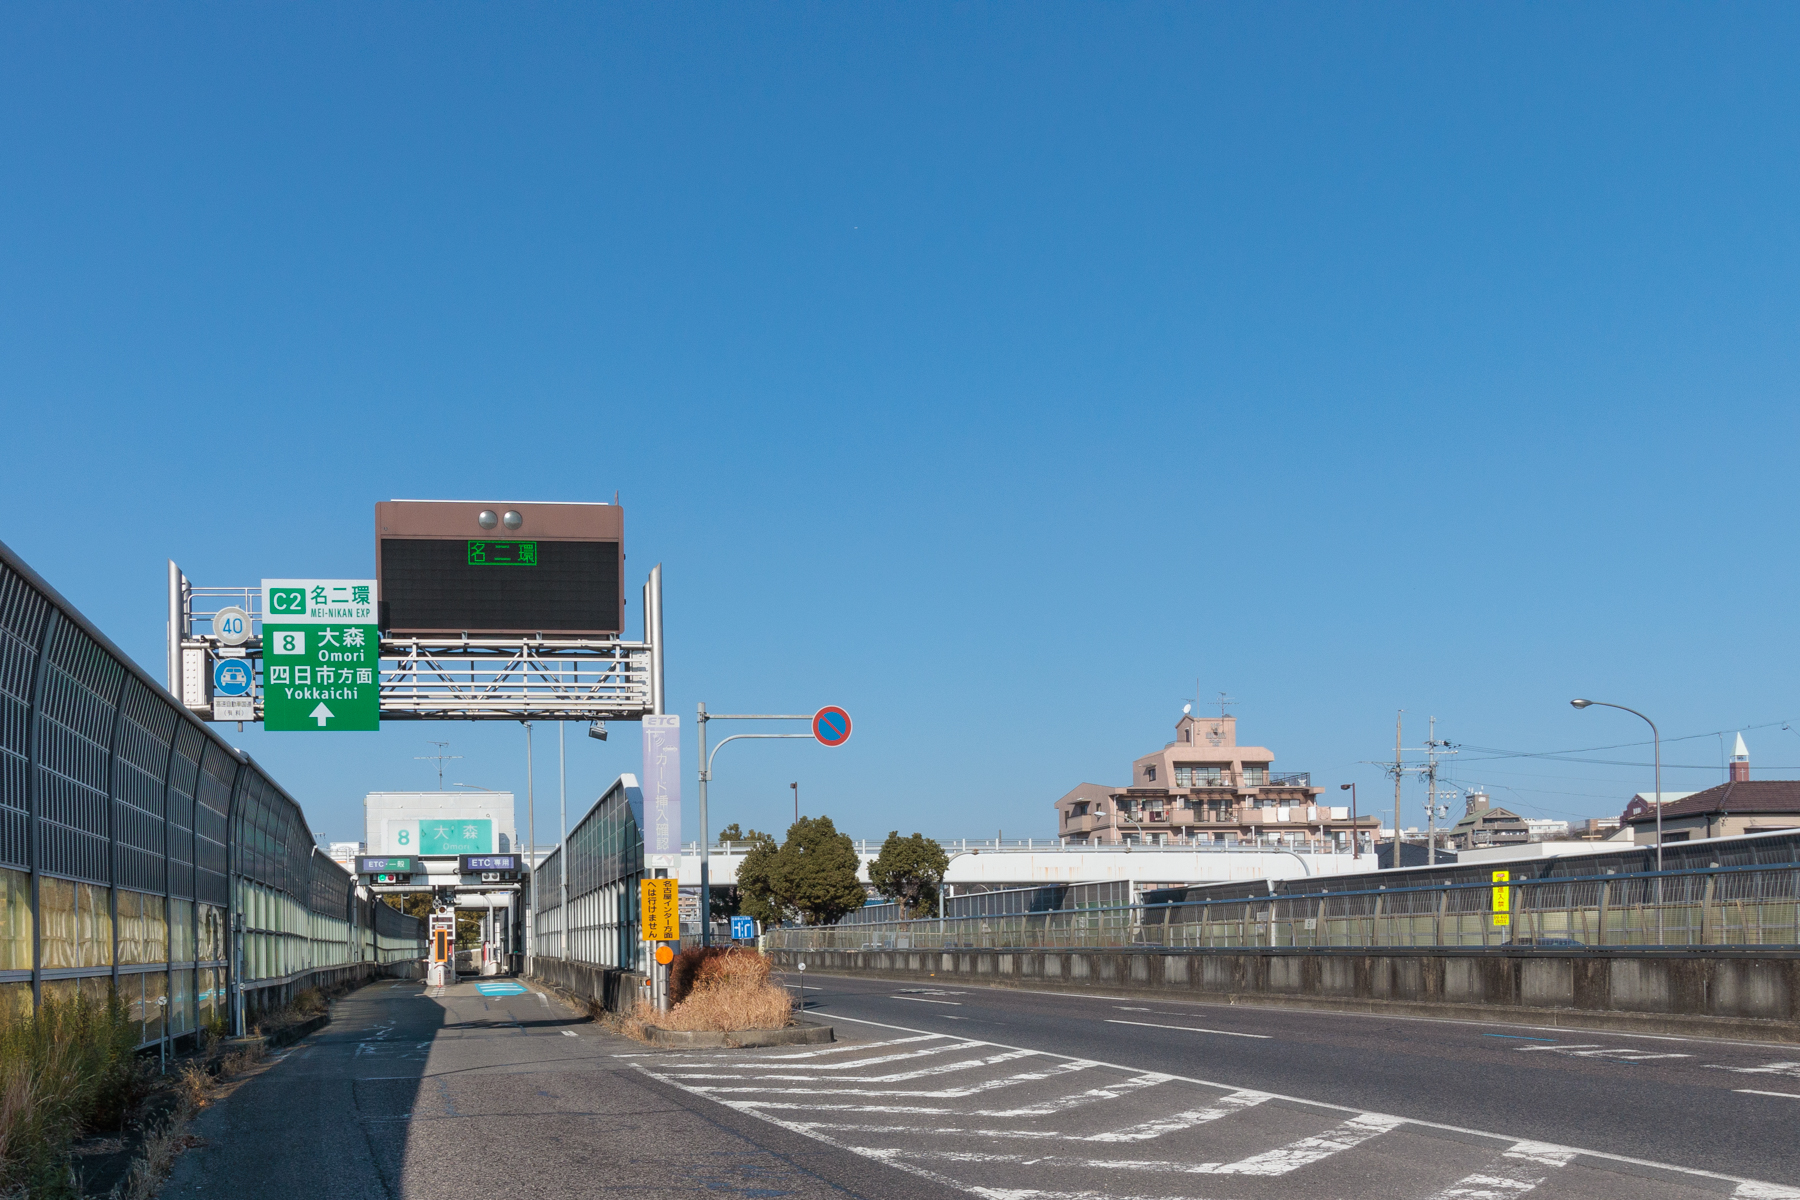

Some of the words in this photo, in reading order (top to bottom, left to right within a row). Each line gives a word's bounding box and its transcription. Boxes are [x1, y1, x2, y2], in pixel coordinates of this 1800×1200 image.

[471, 542, 534, 563] 名二環
[273, 592, 302, 610] C2
[310, 585, 371, 606] 名二環
[310, 608, 353, 618] MEI-NIKAN
[356, 608, 371, 618] EXP
[222, 618, 243, 634] 40
[282, 634, 296, 652] 8
[317, 627, 366, 648] 大森
[318, 649, 365, 662] Omori
[270, 665, 373, 685] 四日市方面
[284, 686, 358, 700] Yokkaichi
[647, 717, 676, 726] ETC
[655, 753, 670, 851] カード挿入確認
[397, 829, 410, 846] 8
[433, 824, 479, 840] 大森
[442, 843, 470, 851] Omori
[471, 859, 491, 867] ETC
[494, 858, 510, 867] 専用
[647, 881, 658, 939] へは行けません
[663, 880, 673, 939] 名古屋インター方面
